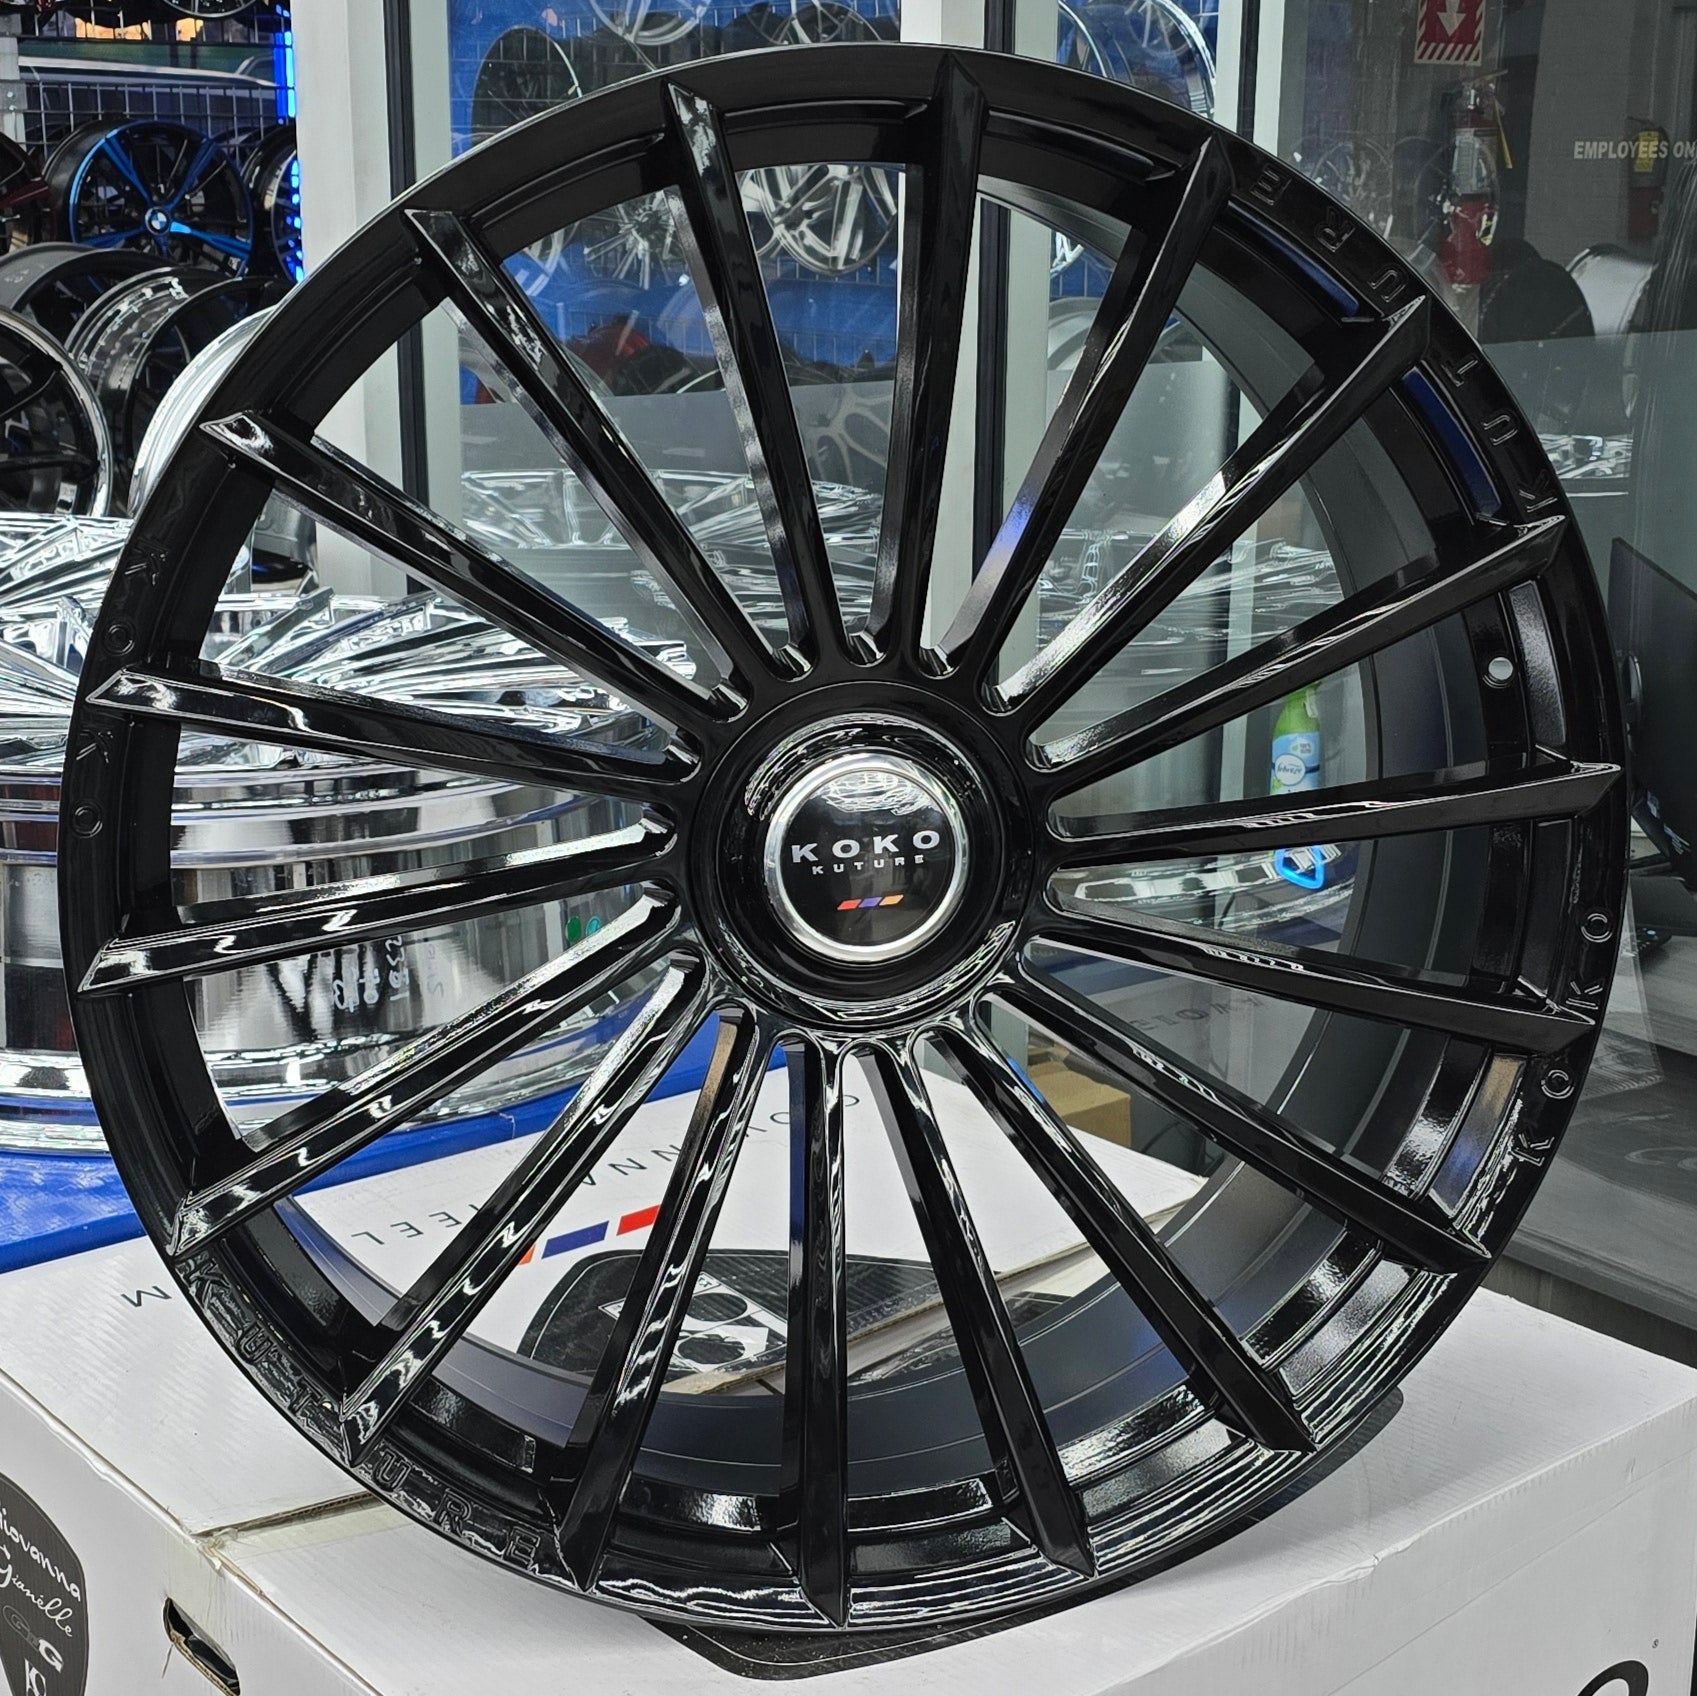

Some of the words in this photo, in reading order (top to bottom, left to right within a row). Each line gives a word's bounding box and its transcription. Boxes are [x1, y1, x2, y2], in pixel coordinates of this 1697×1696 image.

[1573, 140, 1669, 159] EMPLOYEES
[1672, 140, 1697, 159] ON
[791, 830, 940, 863] KOKO
[812, 854, 924, 875] KUTURE
[0, 1507, 81, 1602] iovanna
